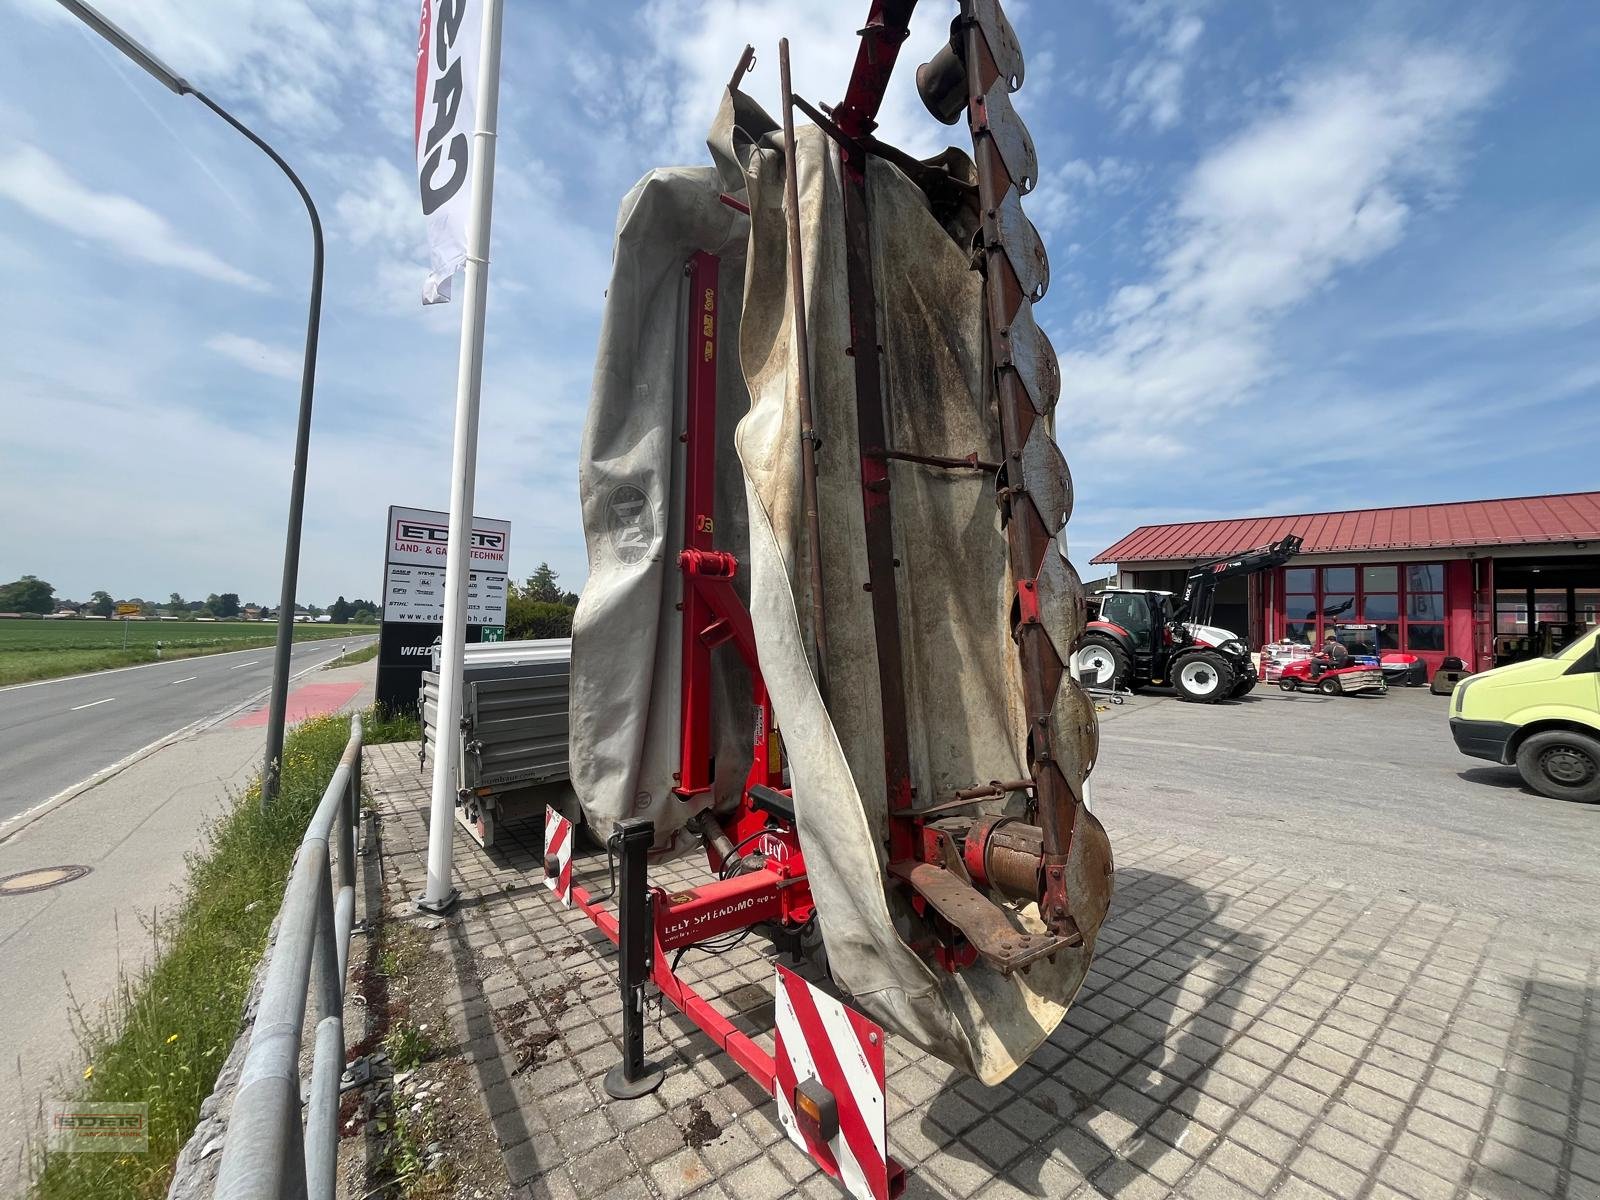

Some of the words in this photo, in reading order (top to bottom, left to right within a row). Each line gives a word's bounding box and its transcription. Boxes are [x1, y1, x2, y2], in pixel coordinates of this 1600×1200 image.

[402, 525, 501, 547] EDR
[395, 543, 422, 553] LAND-
[425, 546, 432, 554] &
[435, 547, 503, 560] GATECHNIK
[399, 613, 493, 622] www.edebh.de
[401, 646, 432, 656] WIED
[764, 837, 782, 862] LELY
[665, 919, 689, 934] LELY
